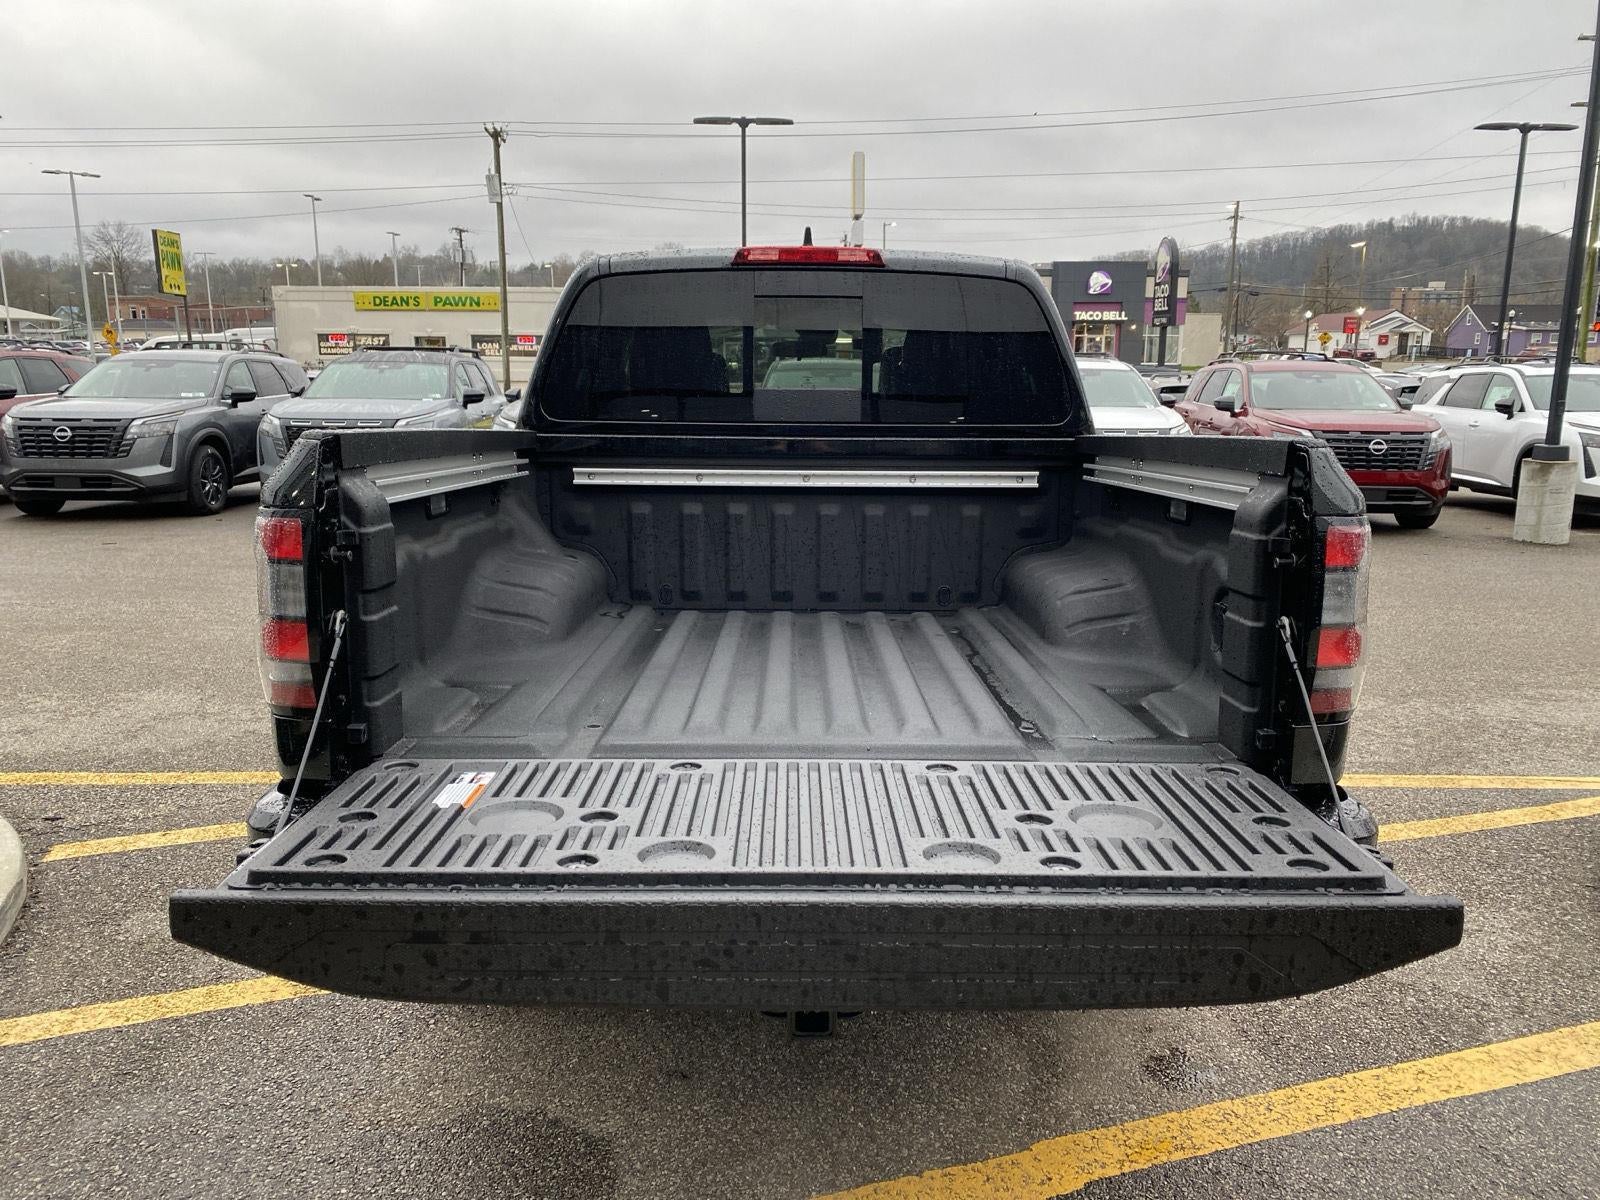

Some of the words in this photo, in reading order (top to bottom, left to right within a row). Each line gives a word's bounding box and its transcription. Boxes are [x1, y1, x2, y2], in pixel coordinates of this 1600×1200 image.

[161, 248, 183, 272] PAWN
[1154, 284, 1169, 298] TACO
[372, 295, 420, 307] DEAN'S
[433, 295, 481, 307] PAWN
[1154, 298, 1169, 311] BELL
[1074, 311, 1102, 320] TACO
[1102, 311, 1128, 320] BELL
[360, 337, 386, 345] FAST
